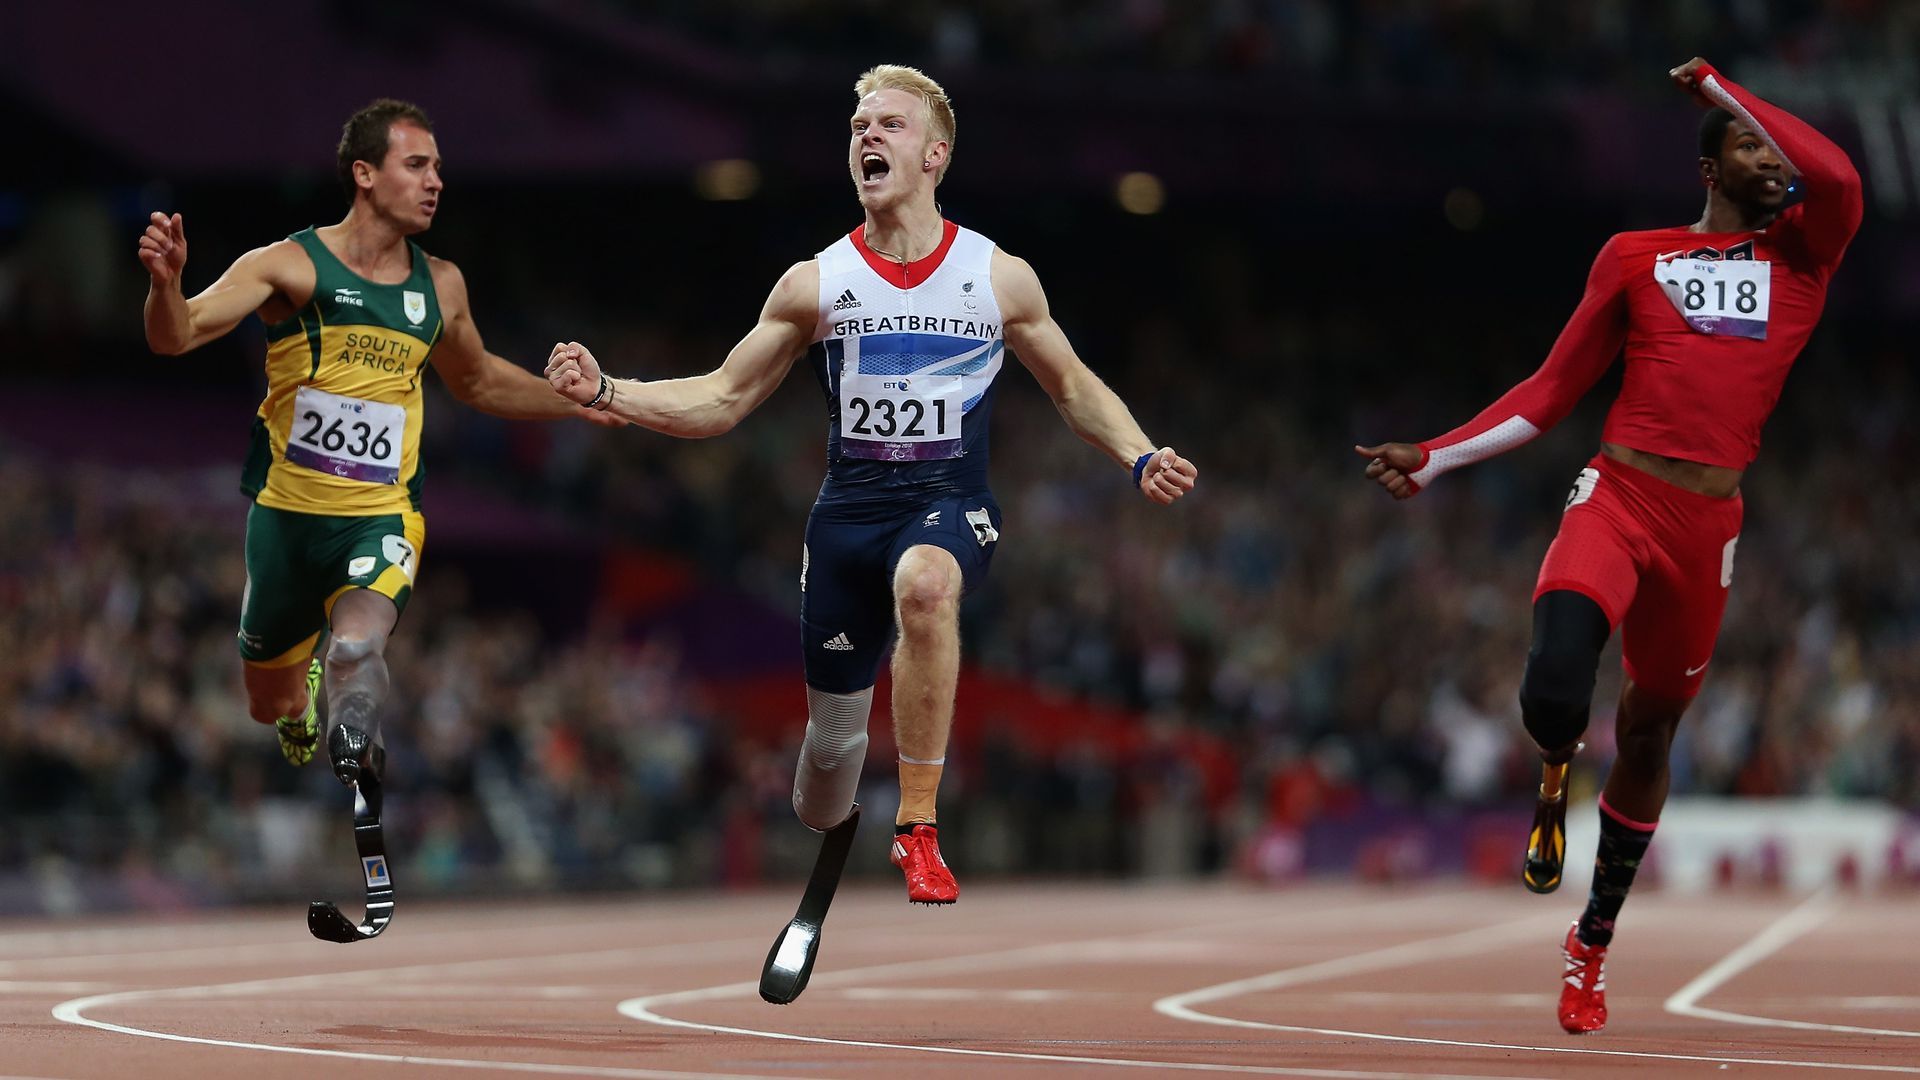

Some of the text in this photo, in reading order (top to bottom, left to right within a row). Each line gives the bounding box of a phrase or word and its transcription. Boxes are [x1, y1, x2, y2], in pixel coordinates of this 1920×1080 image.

[334, 295, 364, 307] ERKE
[833, 300, 862, 311] adidas
[1667, 278, 1757, 314] 818
[346, 333, 412, 359] SOUTH
[337, 350, 405, 375] AFRICA
[849, 397, 945, 437] 2321
[299, 410, 392, 460] 2636
[396, 541, 412, 567] 7
[823, 642, 854, 651] adidas
